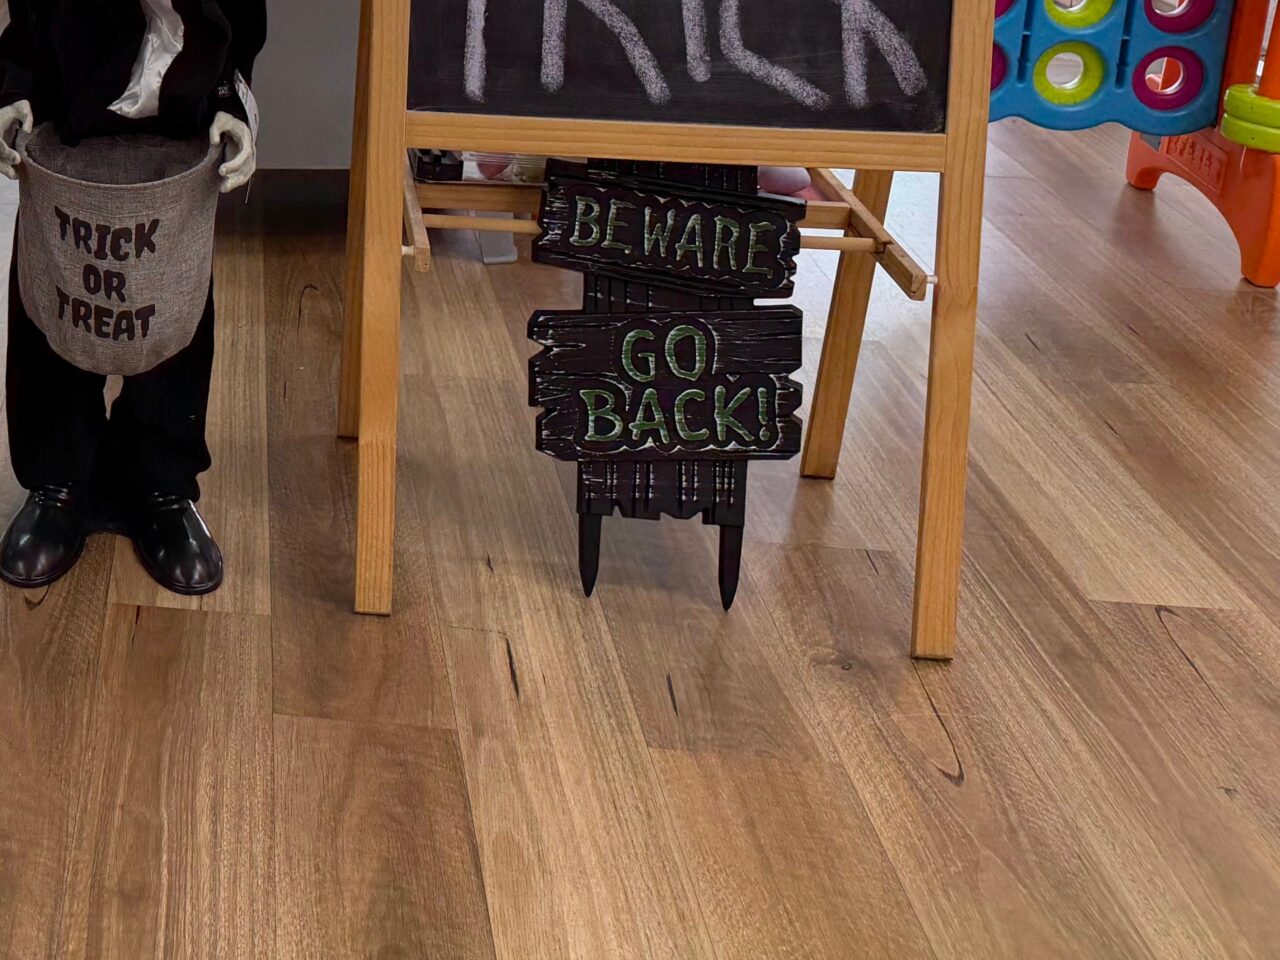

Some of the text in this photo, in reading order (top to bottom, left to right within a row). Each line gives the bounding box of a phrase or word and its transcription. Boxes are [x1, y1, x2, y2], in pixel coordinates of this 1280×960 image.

[54, 205, 160, 262] TRICK
[82, 263, 127, 303] OR
[56, 284, 156, 341] TREAT
[621, 325, 708, 383] GO
[579, 385, 772, 444] BACK!
